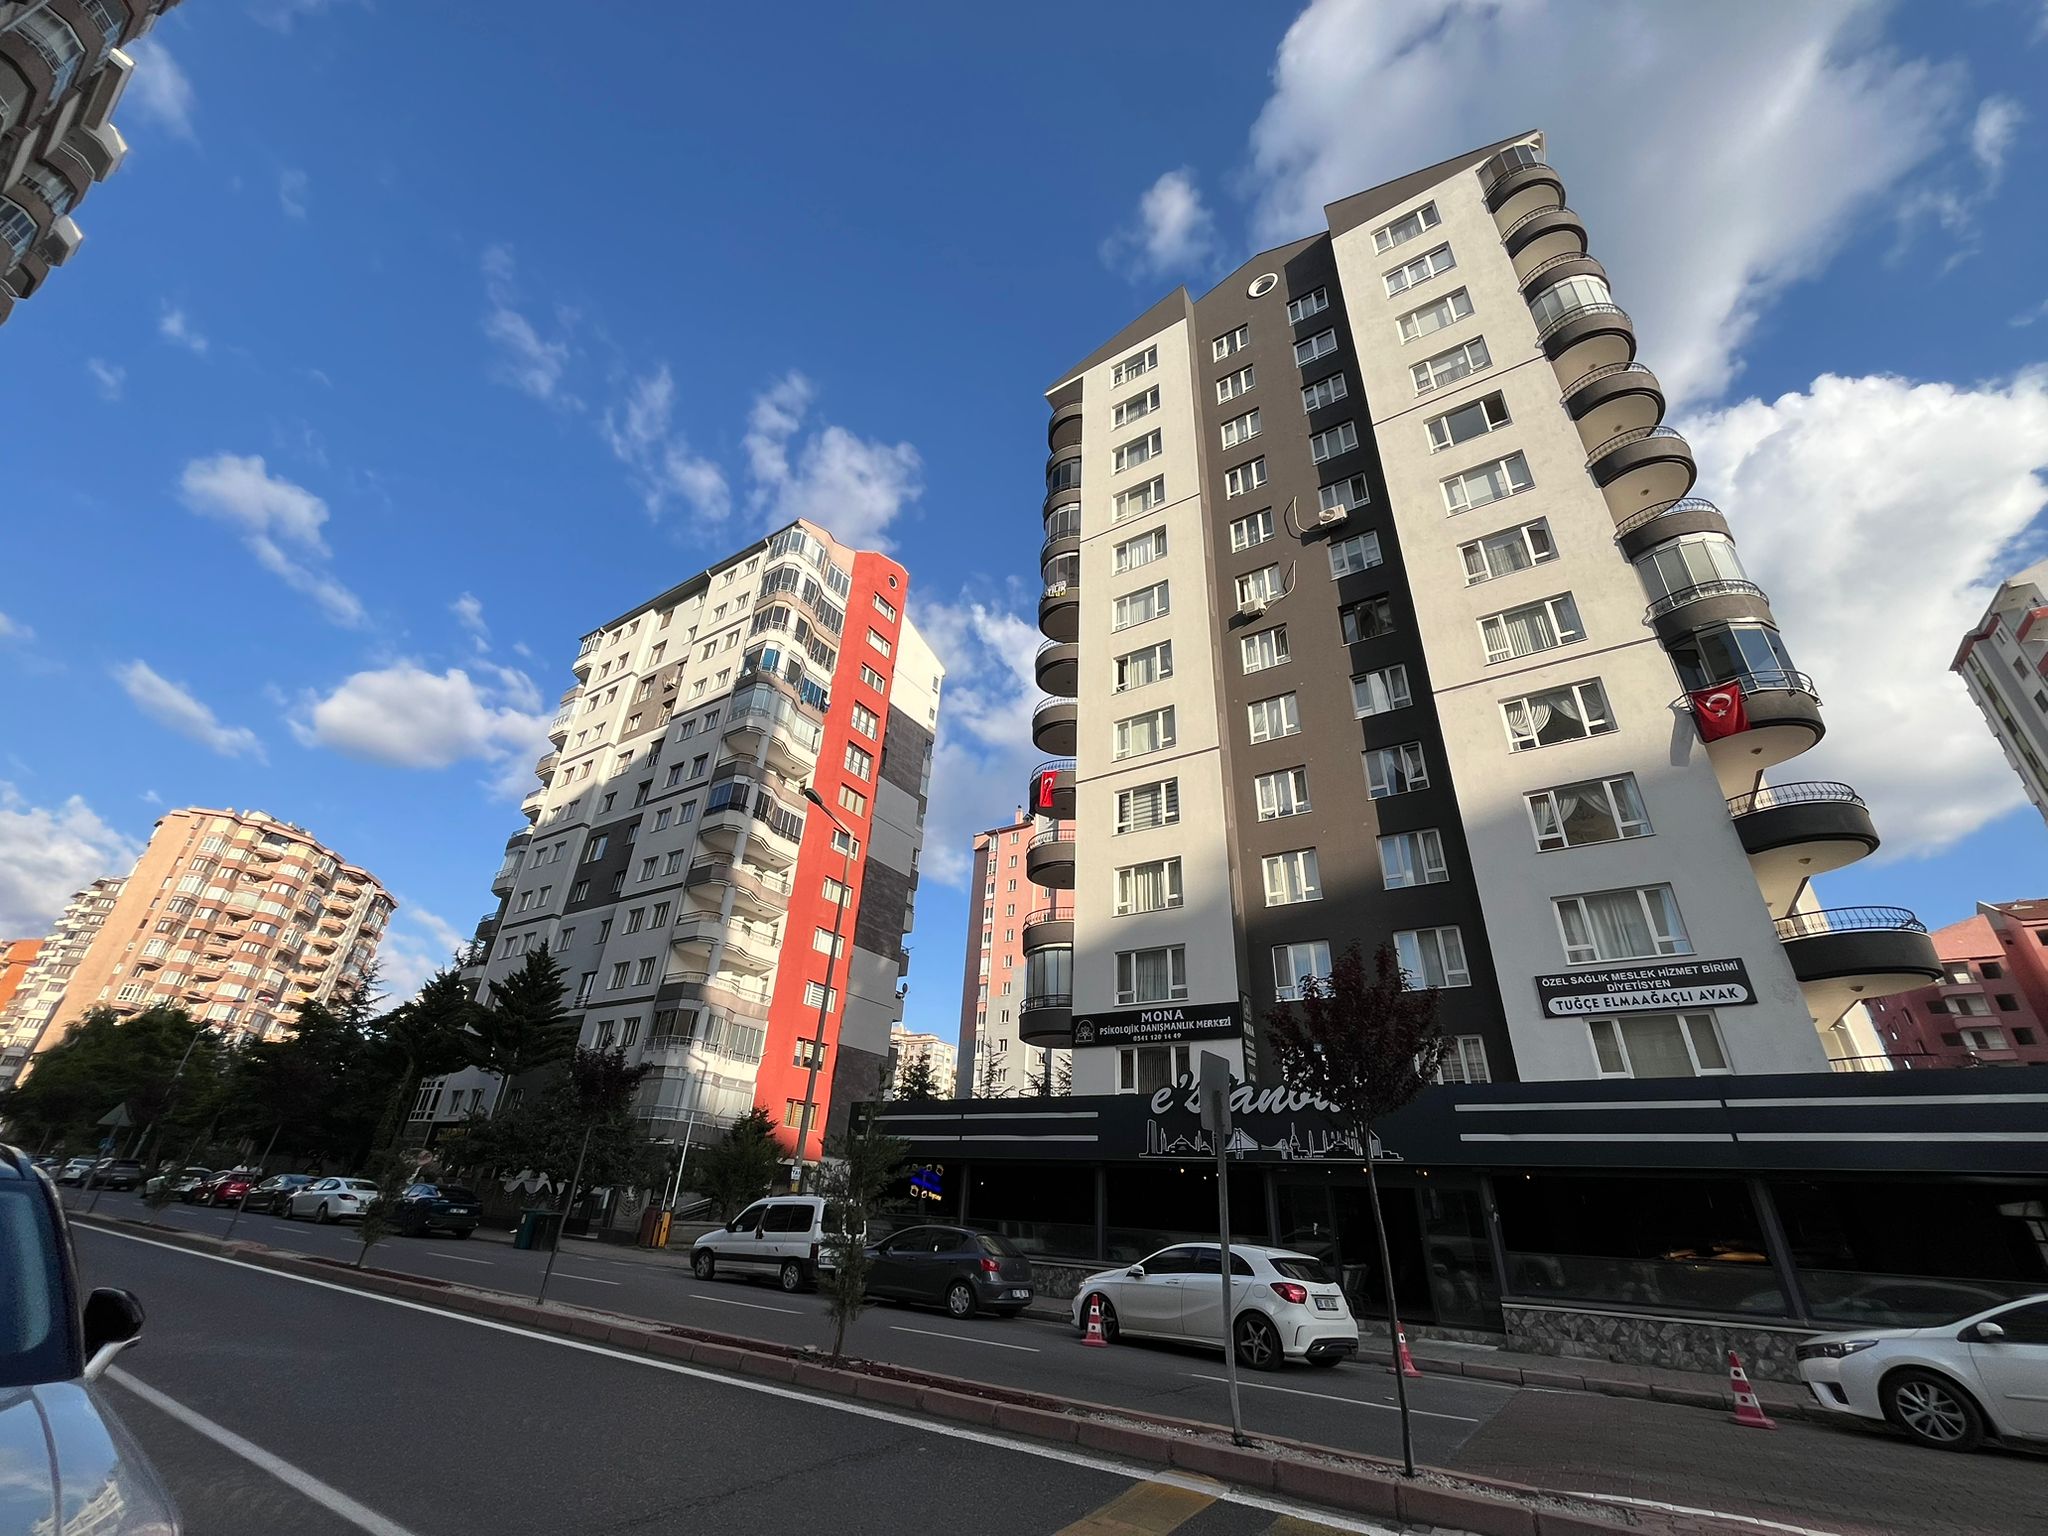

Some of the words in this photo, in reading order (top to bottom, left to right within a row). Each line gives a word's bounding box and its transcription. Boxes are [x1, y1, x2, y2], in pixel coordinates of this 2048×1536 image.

[1541, 977, 1569, 987] ÖZEL
[1571, 973, 1609, 985] SAĞLIK
[1611, 969, 1656, 981] MESLEK
[1658, 966, 1699, 978] HİZMET
[1701, 961, 1739, 974] BİRİMİ
[1606, 979, 1671, 992] DİYETİSYEN
[1555, 997, 1600, 1013] TUĞÇE
[1604, 991, 1694, 1009] ELMAAĞAÇLI
[1141, 1009, 1185, 1022] MONA
[1099, 1023, 1140, 1035] PSİKOLOJİK
[1140, 1020, 1195, 1033] DANIŞMANLIK
[1196, 1016, 1232, 1028] MERKEZİ
